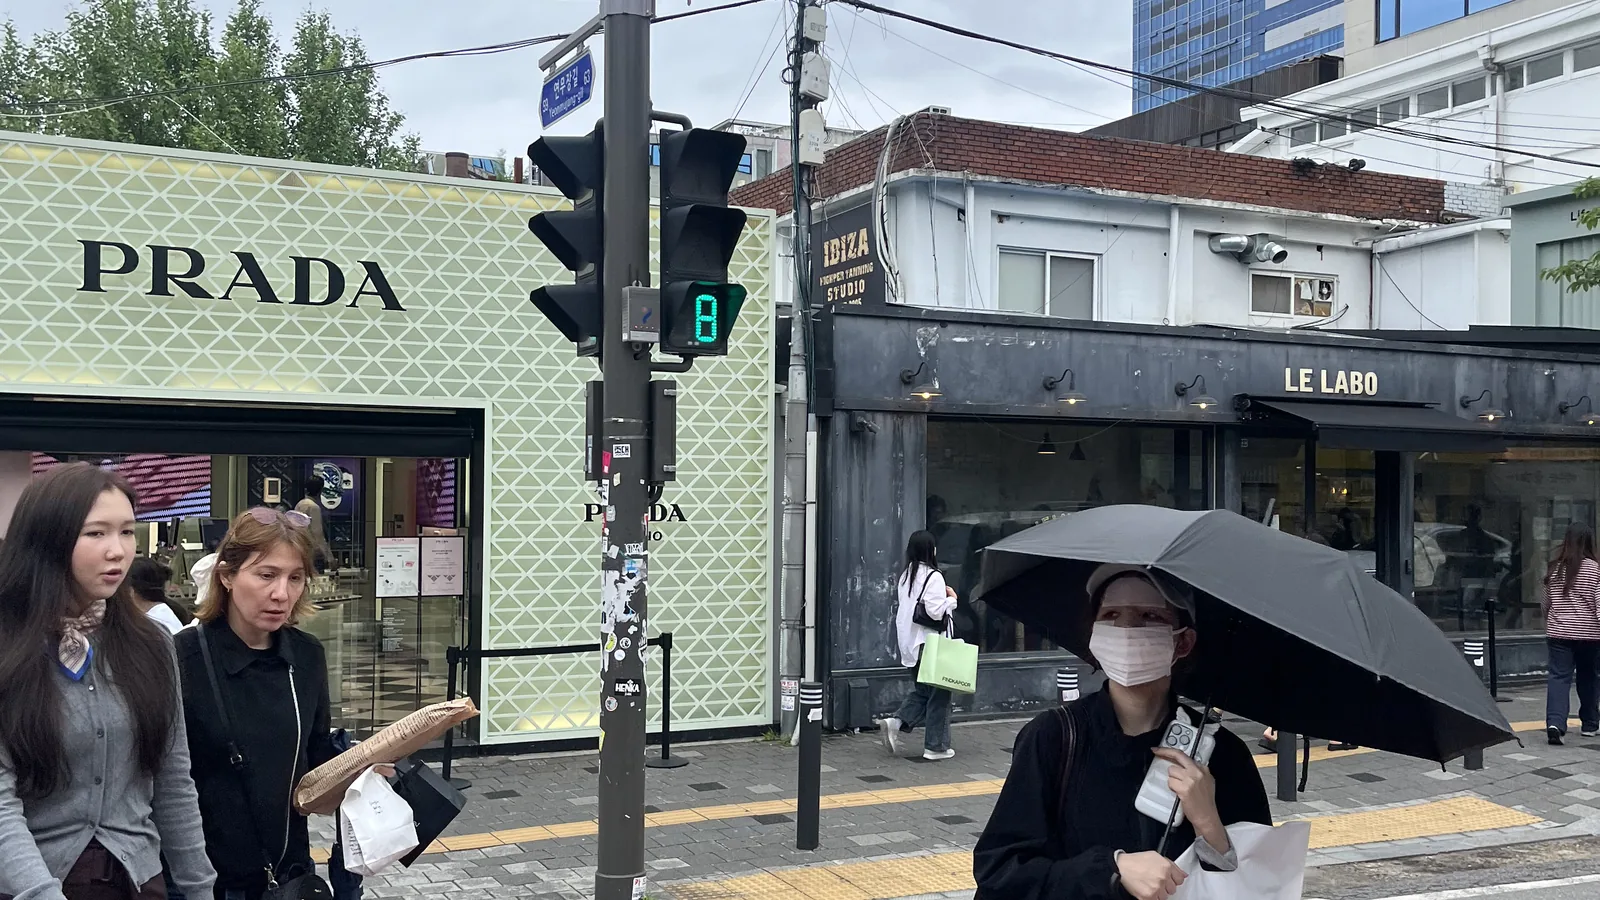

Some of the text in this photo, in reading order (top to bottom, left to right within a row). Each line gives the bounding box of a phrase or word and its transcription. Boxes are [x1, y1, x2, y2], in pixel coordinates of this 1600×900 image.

[553, 66, 578, 100] 연무장길
[584, 69, 591, 85] 63
[542, 98, 549, 113] 59
[823, 228, 869, 268] IBIZA
[77, 239, 406, 311] PRADA
[845, 262, 874, 280] TANNING
[827, 278, 865, 302] STUDIO
[695, 294, 717, 343] 8
[1285, 367, 1378, 396] LE LABO
[584, 503, 687, 522] PDA
